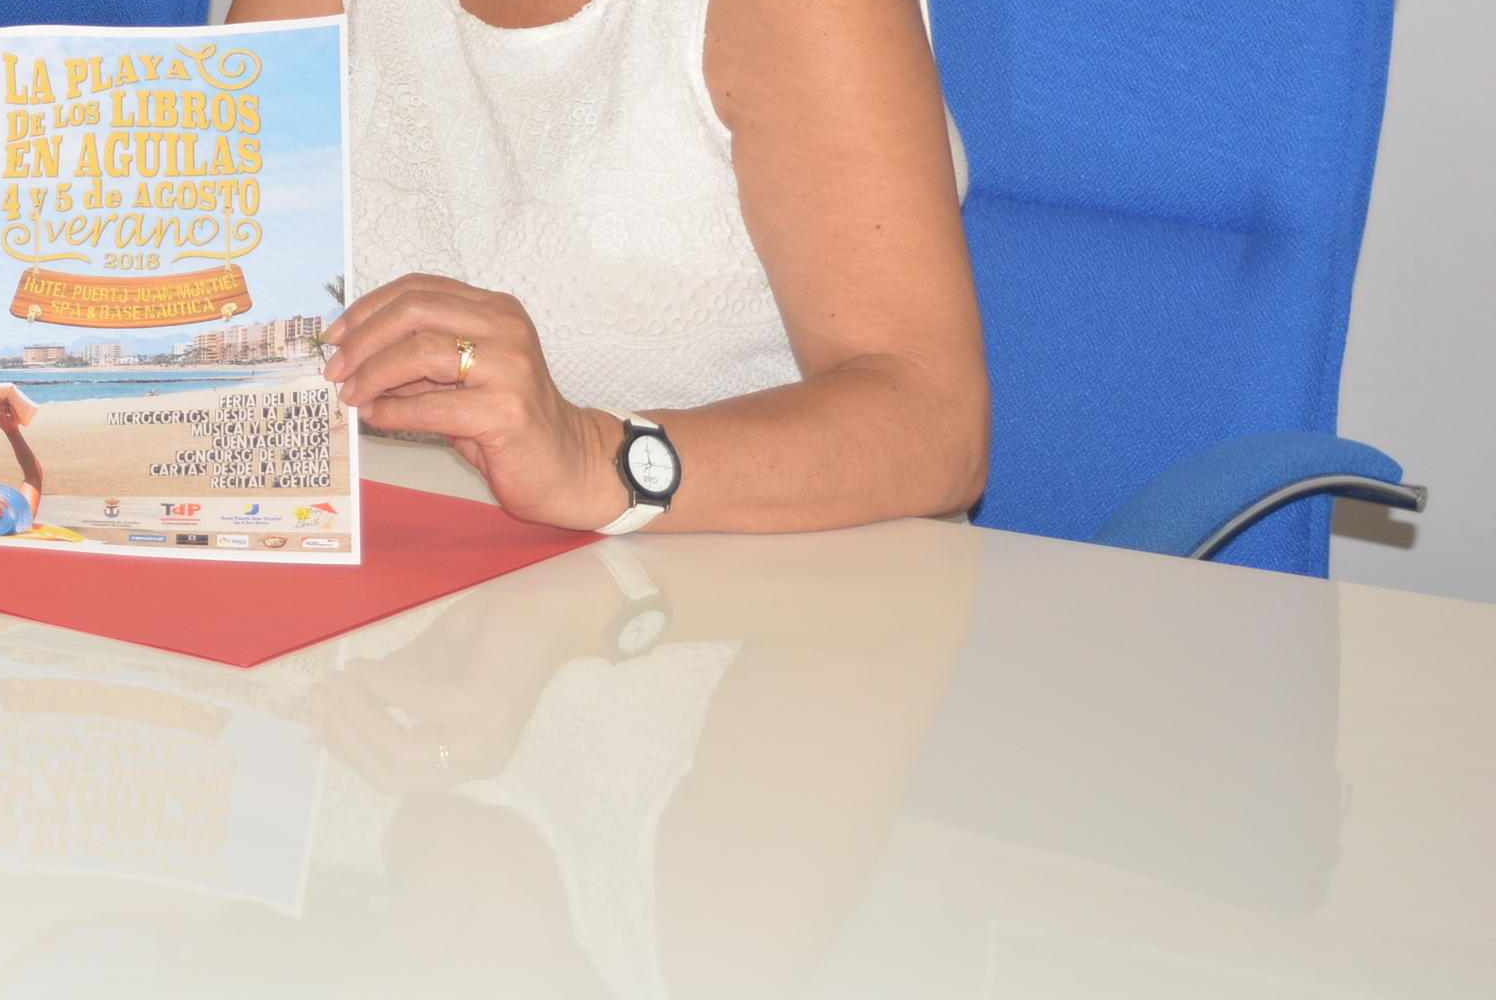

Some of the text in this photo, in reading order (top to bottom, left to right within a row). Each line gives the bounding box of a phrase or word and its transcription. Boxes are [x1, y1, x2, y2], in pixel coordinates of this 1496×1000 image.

[2, 52, 192, 105] LA PLAYA
[6, 89, 261, 142] DE LOS LIBROS
[2, 131, 263, 178] EN AGUILAS
[1, 176, 261, 221] 4 y 5 de AGOSTO
[45, 211, 220, 249] verano
[103, 252, 161, 270] 2018
[23, 273, 241, 303] HOTEL PUERTO JUAN MONTIEL
[51, 300, 82, 318] SPA
[100, 305, 141, 321] BASE
[219, 388, 329, 408] FERIA DEL LIBRO
[107, 409, 209, 425] MICROCORTOS
[215, 407, 254, 422] DESDE
[260, 406, 277, 420] LA
[250, 421, 260, 435] Y
[266, 418, 329, 434] SORTEOS
[212, 431, 329, 450] CUENTACUENTOS
[176, 449, 253, 464] CONCURSO
[259, 447, 274, 461] DE
[150, 459, 330, 476] CARTAS DESDE LA ARENA
[210, 475, 265, 489] RECITAL
[160, 502, 202, 516] TdP
